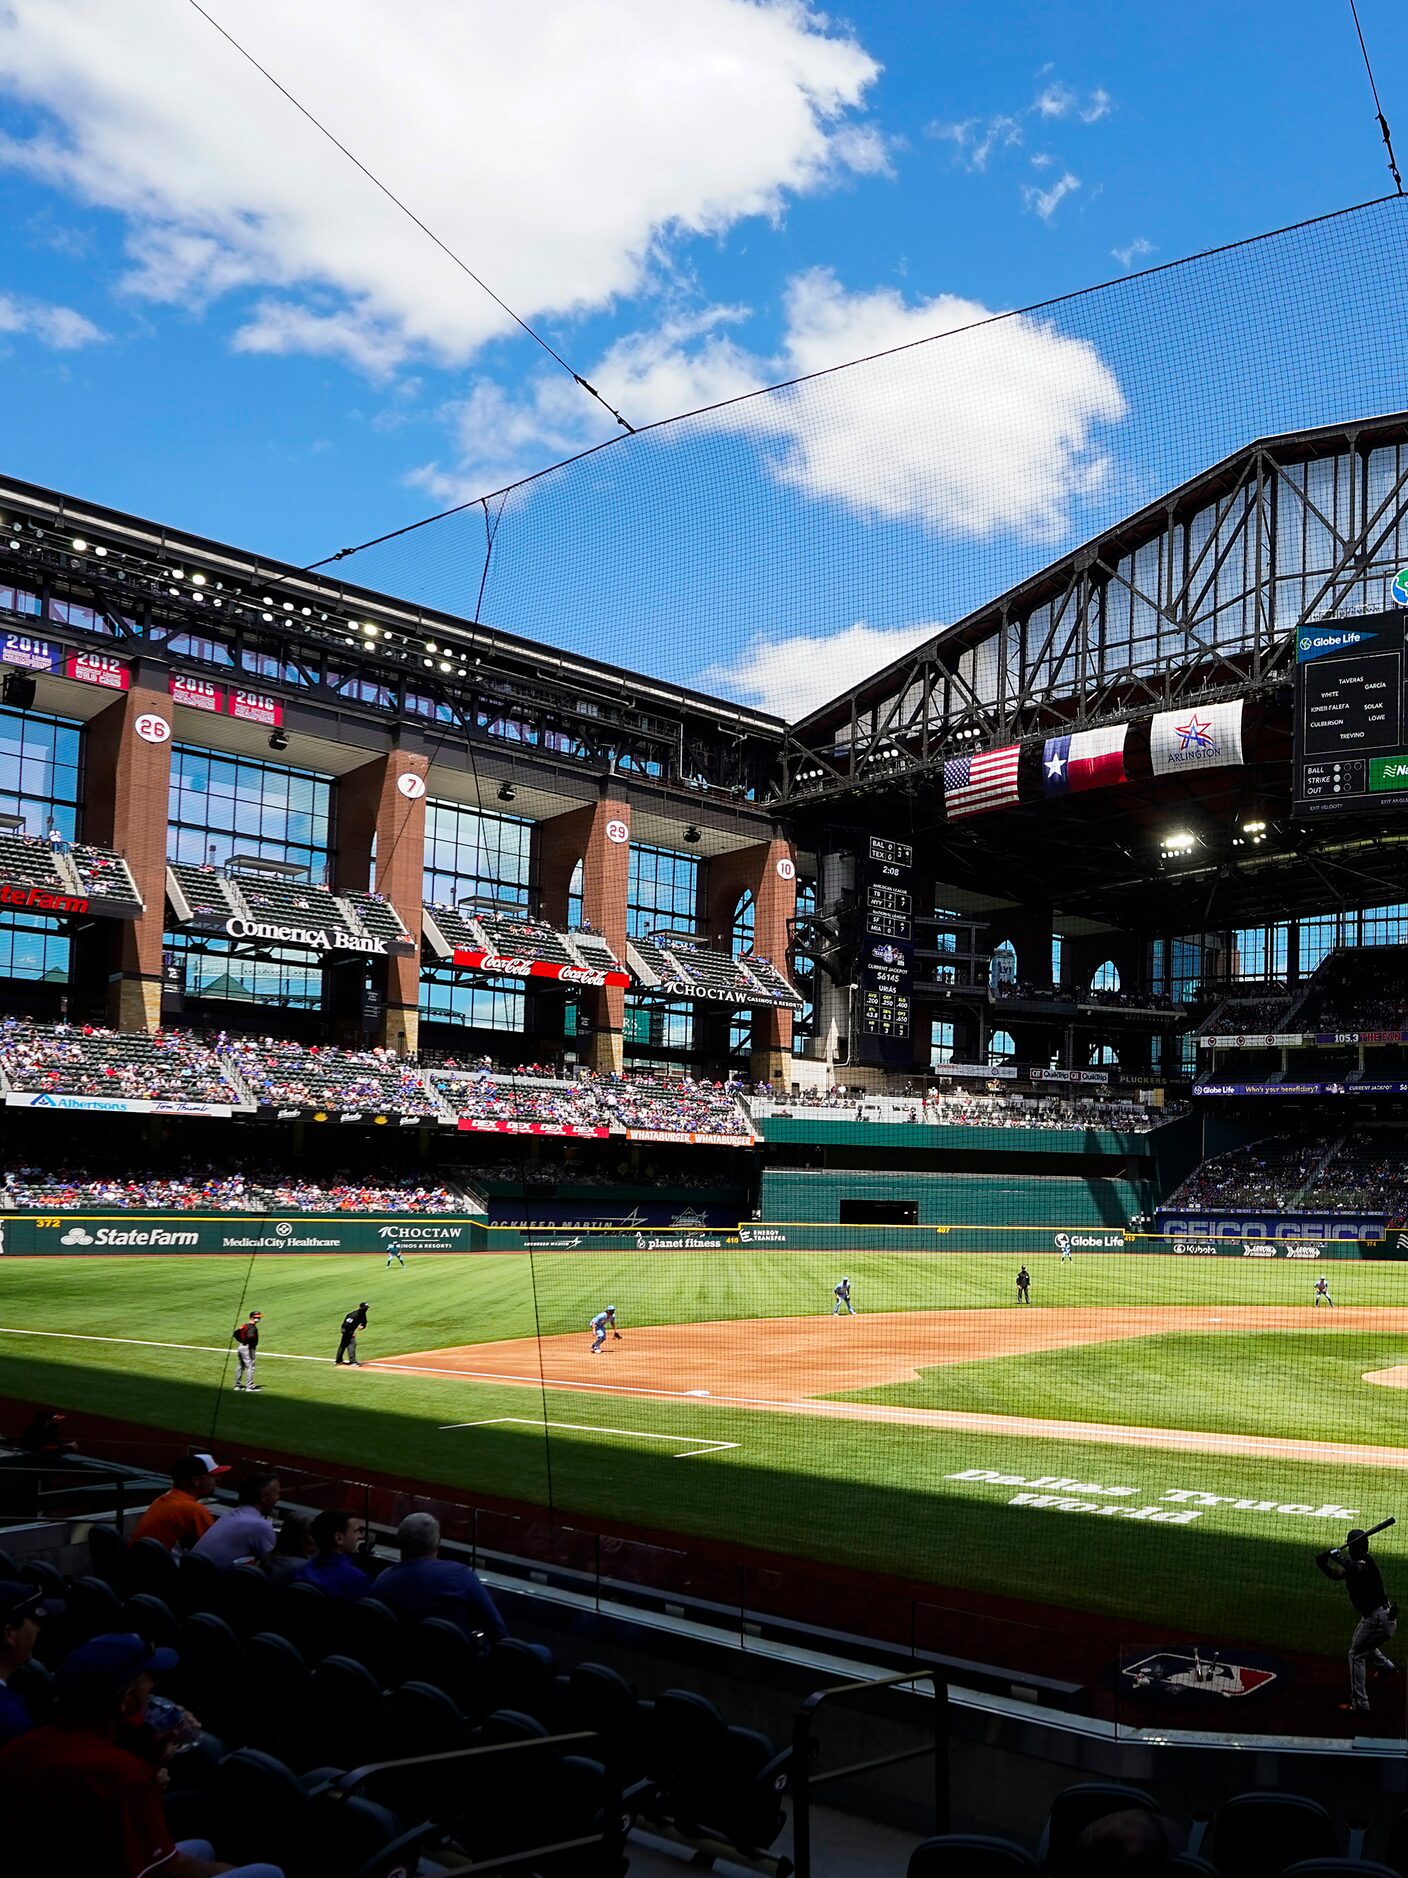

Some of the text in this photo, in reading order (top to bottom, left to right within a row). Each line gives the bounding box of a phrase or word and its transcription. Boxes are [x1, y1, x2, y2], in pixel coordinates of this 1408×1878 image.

[7, 634, 48, 655] 2011
[1313, 633, 1360, 646] Globe Life
[77, 651, 119, 672] 2012
[175, 675, 214, 695] 2015
[236, 690, 274, 710] 2016
[141, 720, 164, 737] 26
[1167, 748, 1221, 764] ARLINGTON
[408, 779, 417, 792] 7
[1308, 776, 1330, 784] STRIKE
[610, 825, 625, 838] 29
[873, 840, 884, 848] BAL
[872, 850, 884, 858] TEX
[780, 862, 792, 876] 10
[883, 866, 899, 876] 2:08
[334, 931, 388, 954] Bank
[480, 955, 535, 976] Coca-Cola
[558, 966, 608, 985] Coca-Cola
[672, 982, 803, 1009] CHOCTAW CASINOS RESORTS
[1334, 1032, 1400, 1042] 105.3 THE FAN
[1043, 1070, 1107, 1082] QuikTrip QuikTrip
[1120, 1076, 1167, 1085] PLUCKERS
[59, 1099, 209, 1112] Albertsons Tom Thumb
[472, 1120, 498, 1128] DEX
[507, 1122, 532, 1130] DEX
[540, 1124, 566, 1132] DEX
[572, 1125, 595, 1134] DEX
[630, 1130, 691, 1143] WHATABURGER
[694, 1133, 751, 1146] WHATABURGER
[36, 1220, 61, 1228] 372
[387, 1226, 462, 1238] CHOCTAW
[1164, 1221, 1267, 1243] GEICO
[1275, 1222, 1385, 1242] GEICO
[223, 1238, 340, 1248] Medical City Healthcare
[648, 1238, 721, 1250] planet fitness
[1071, 1236, 1124, 1246] Globe Life
[1186, 1245, 1216, 1254] Kubota
[944, 1469, 1360, 1519] Dallas Truck
[1007, 1493, 1204, 1524] World
